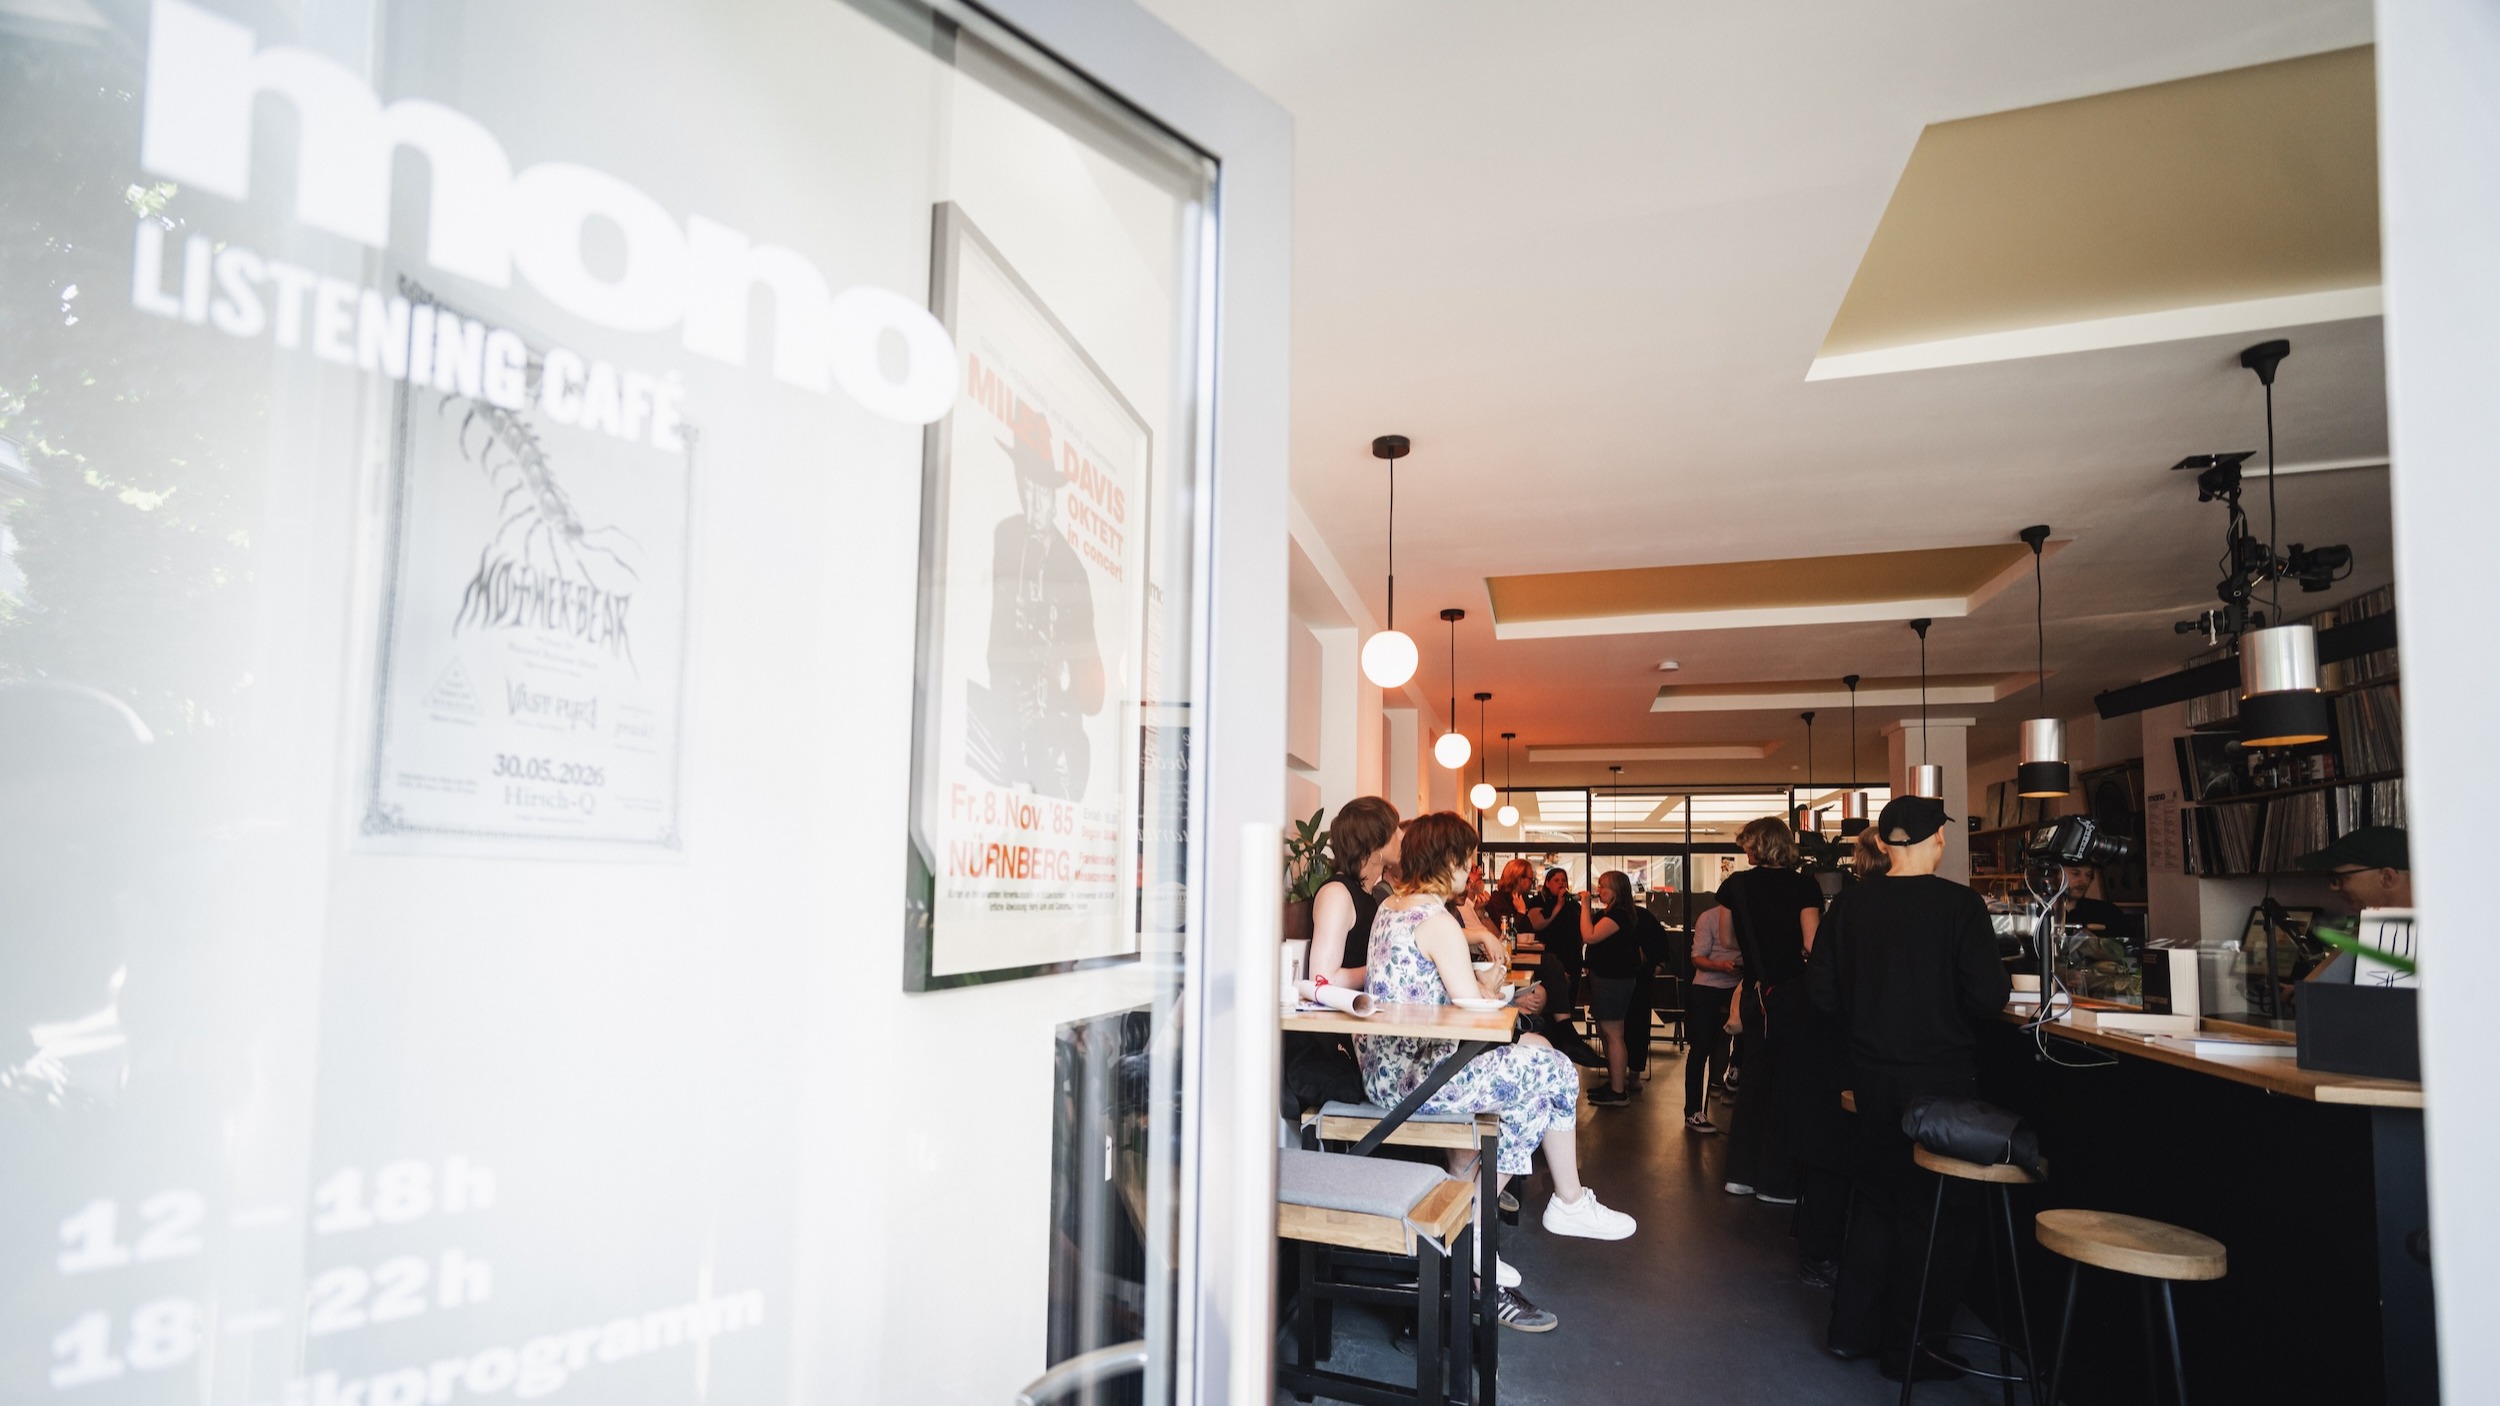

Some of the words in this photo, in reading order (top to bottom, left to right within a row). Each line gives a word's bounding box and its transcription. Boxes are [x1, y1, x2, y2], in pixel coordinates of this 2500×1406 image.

[141, 0, 959, 425] mono
[132, 219, 528, 411] LISTENING
[542, 346, 688, 455] CAFÉ
[1063, 439, 1125, 525] DAVIS
[1067, 492, 1124, 557] OKTETT
[1067, 523, 1079, 548] in
[1083, 539, 1124, 583] concert
[491, 752, 606, 788] 30.05.2026
[1005, 792, 1045, 832] Nov.
[949, 833, 1071, 881] NÜRNBERG
[57, 1188, 207, 1275] 12
[50, 1298, 202, 1390] 18
